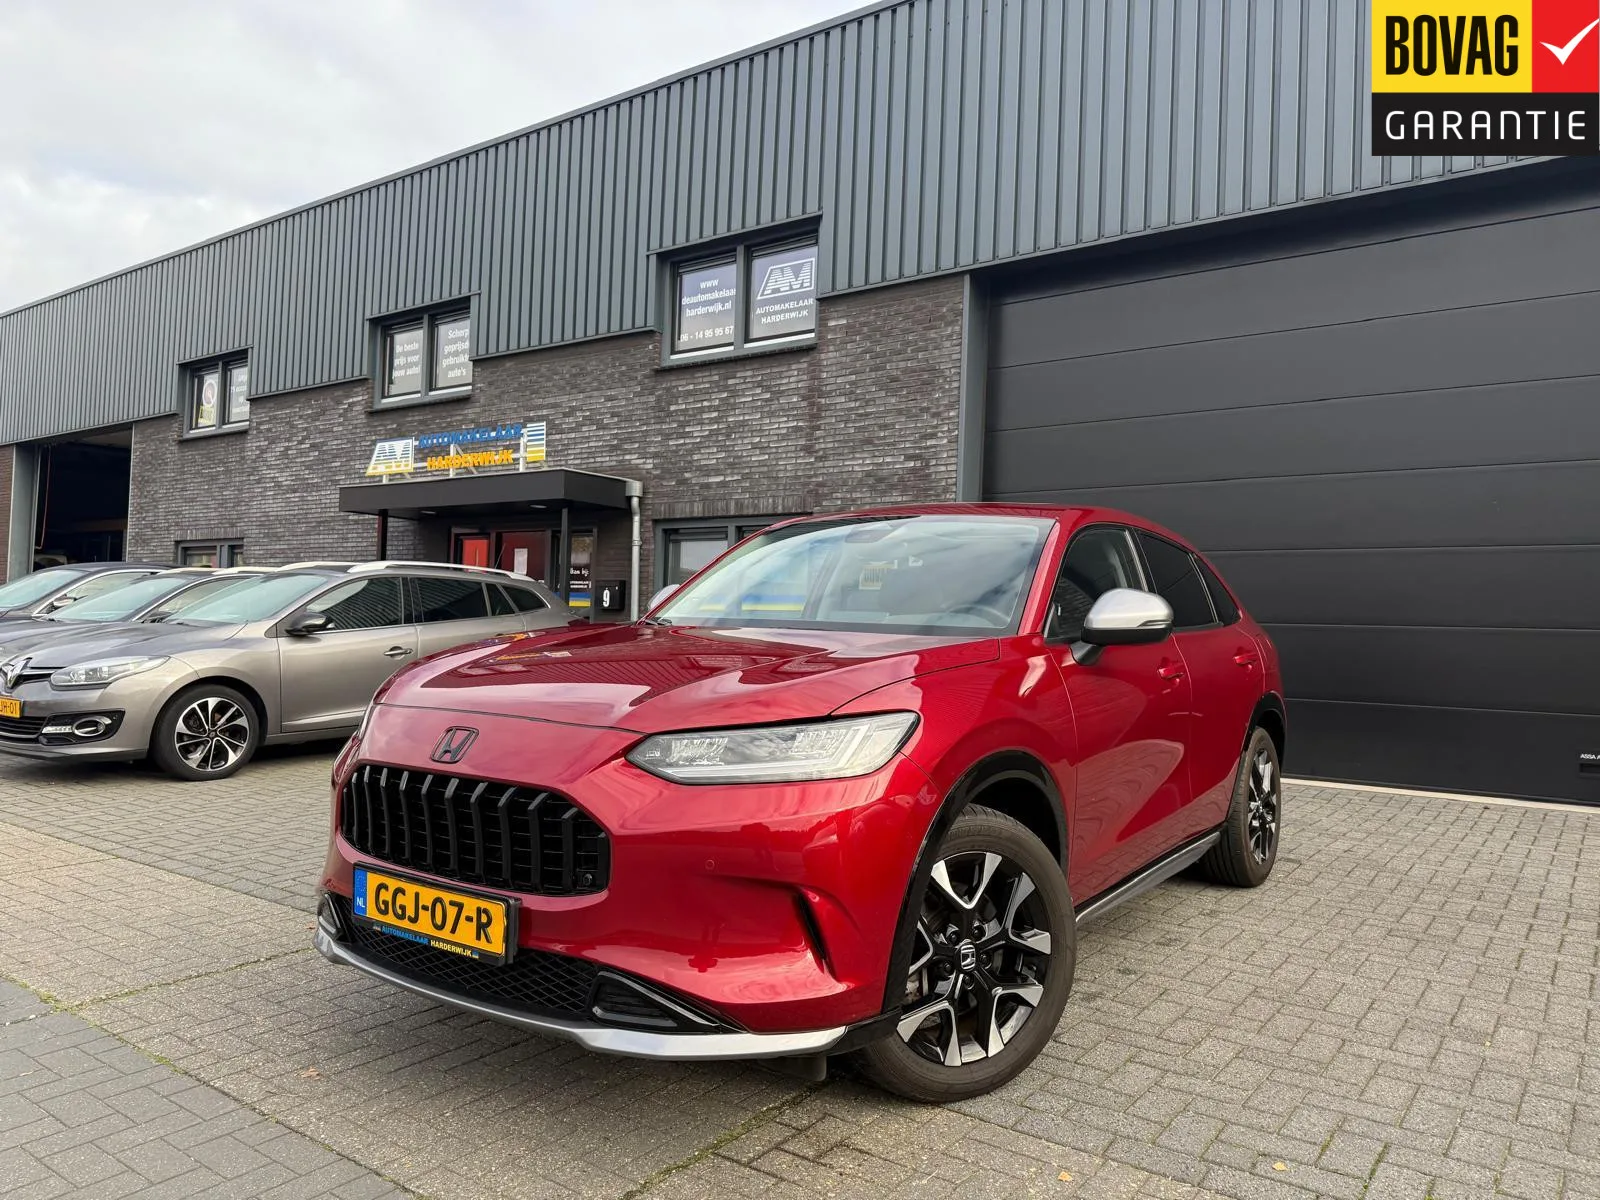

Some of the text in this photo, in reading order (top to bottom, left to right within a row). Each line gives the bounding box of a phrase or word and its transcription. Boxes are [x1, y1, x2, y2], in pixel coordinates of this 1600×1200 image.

[686, 300, 732, 317] harderwijk.nl
[755, 298, 814, 314] AUTOMAKELAAR
[761, 309, 808, 325] HARDERWIJK
[695, 330, 703, 340] 14
[418, 423, 523, 448] AUTOMAKELAAR
[426, 449, 514, 471] HARDERWIJK
[603, 590, 610, 607] 9
[356, 896, 366, 908] NL
[374, 882, 493, 944] GGJ-07-R
[382, 925, 429, 945] AUTOMAKELAAR
[430, 939, 472, 957] HARDERWIJK
